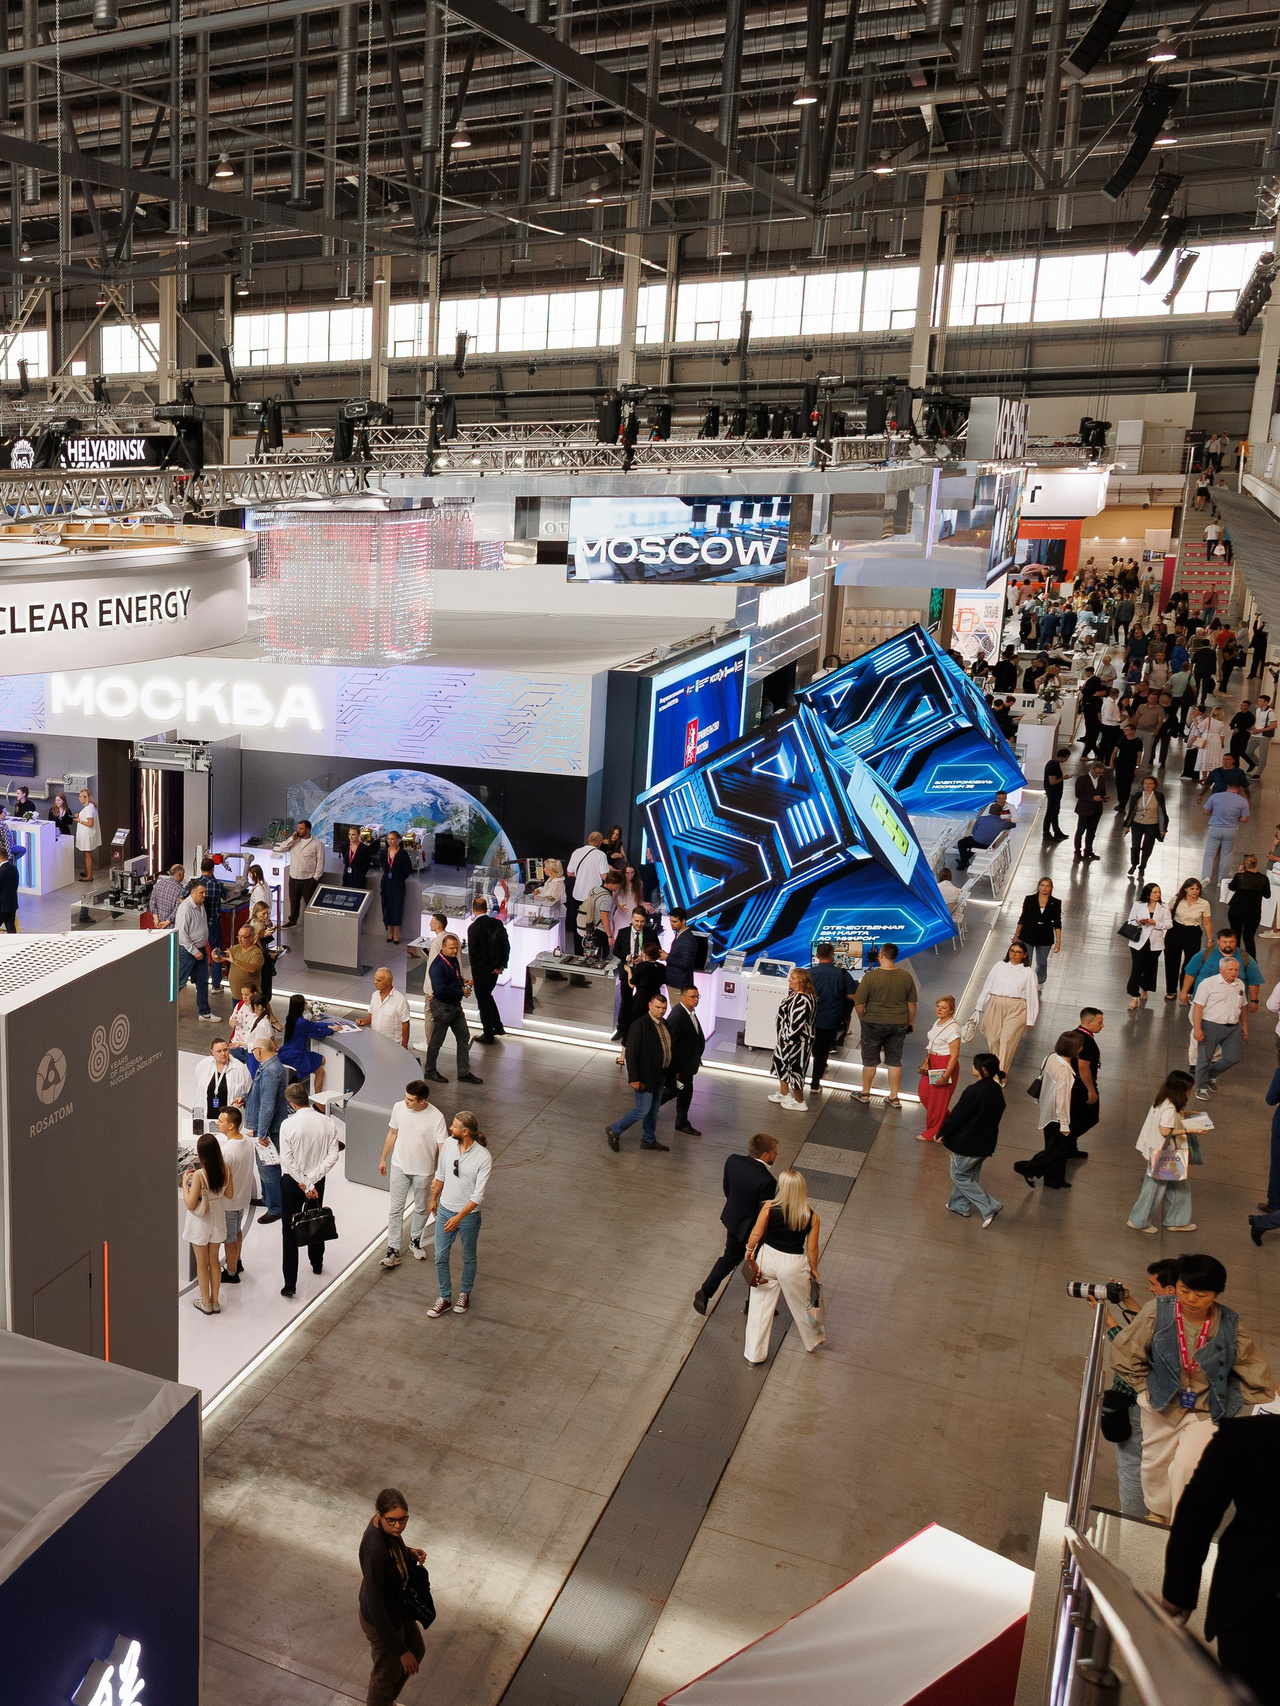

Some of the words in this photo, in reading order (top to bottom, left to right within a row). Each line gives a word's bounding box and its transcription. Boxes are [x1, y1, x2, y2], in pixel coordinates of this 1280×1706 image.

[61, 439, 146, 461] HELYABINSK
[577, 536, 779, 567] MOSCOW
[98, 588, 192, 627] ENERGY
[50, 673, 324, 731] МОСКВА
[109, 1071, 118, 1079] OF
[120, 1055, 143, 1073] RUSSIAN
[109, 1068, 136, 1087] NUCLEAR
[136, 1051, 163, 1071] INDUSTRY
[110, 1055, 129, 1070] YEARS
[29, 1102, 74, 1138] ROSATOM
